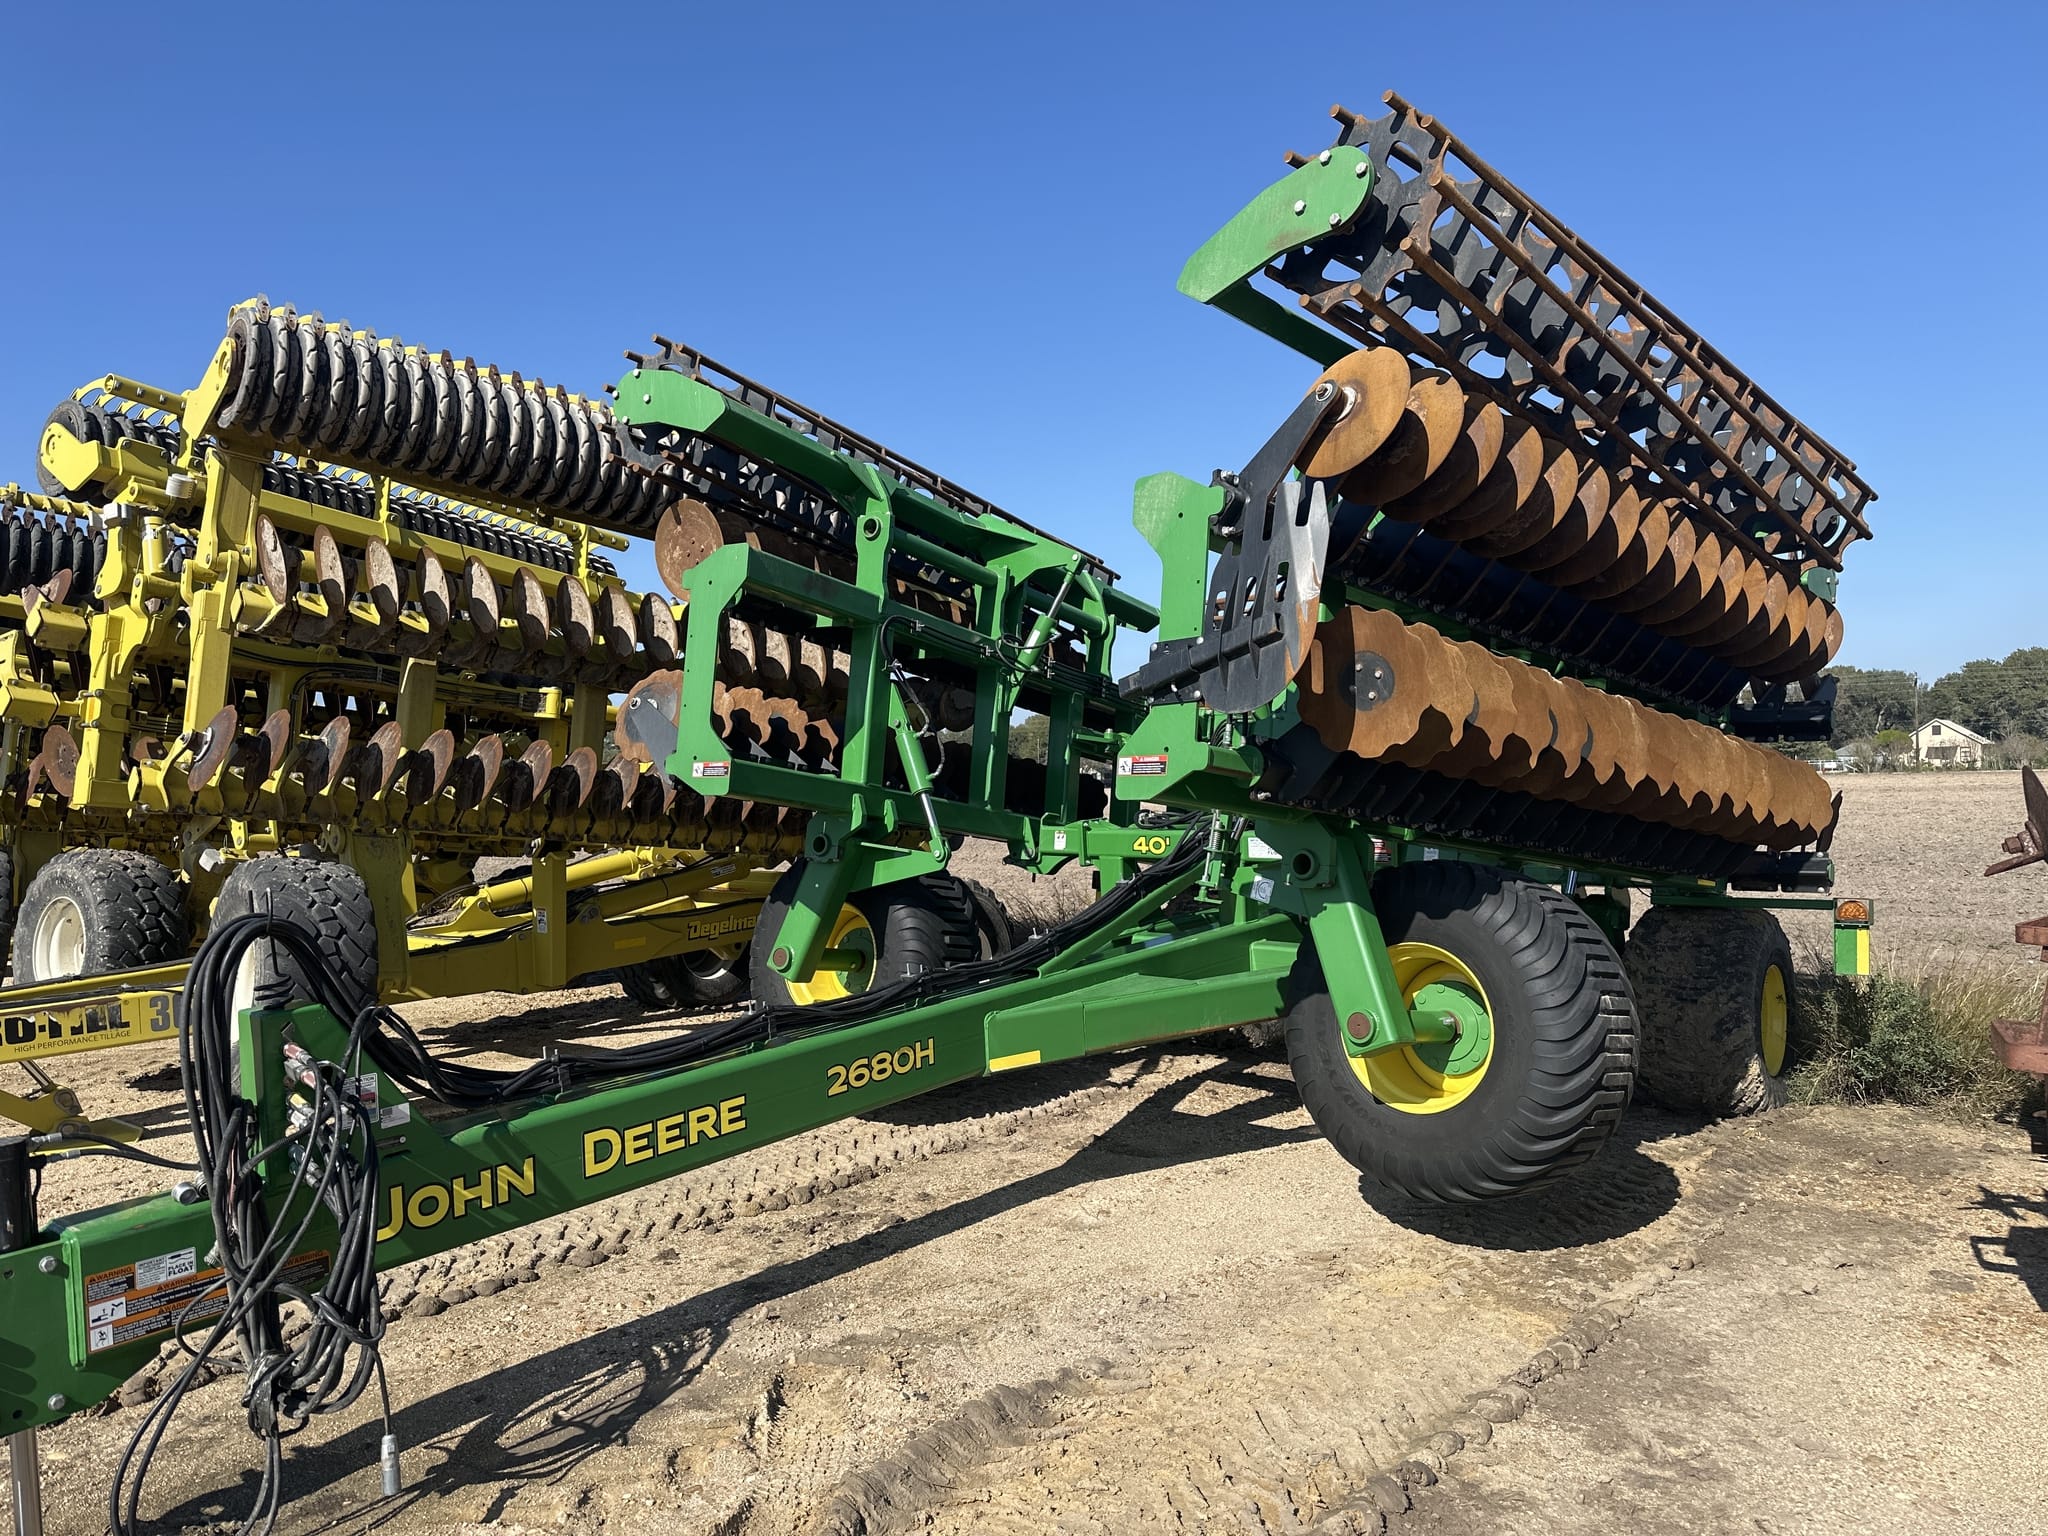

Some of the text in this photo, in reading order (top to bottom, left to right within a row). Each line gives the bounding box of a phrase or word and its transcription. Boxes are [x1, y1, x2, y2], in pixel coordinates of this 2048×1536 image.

[1132, 836, 1171, 856] 40'
[688, 915, 757, 940] Degelma
[14, 1030, 131, 1053] HIGH PERFORMANCE TILLAGE
[826, 1037, 937, 1099] 2680H
[376, 1094, 748, 1243] JOHN DEERE
[97, 1266, 133, 1281] WARNING
[168, 1262, 186, 1270] PLACE
[168, 1265, 194, 1276] FLOAT
[163, 1275, 198, 1289] WARNING
